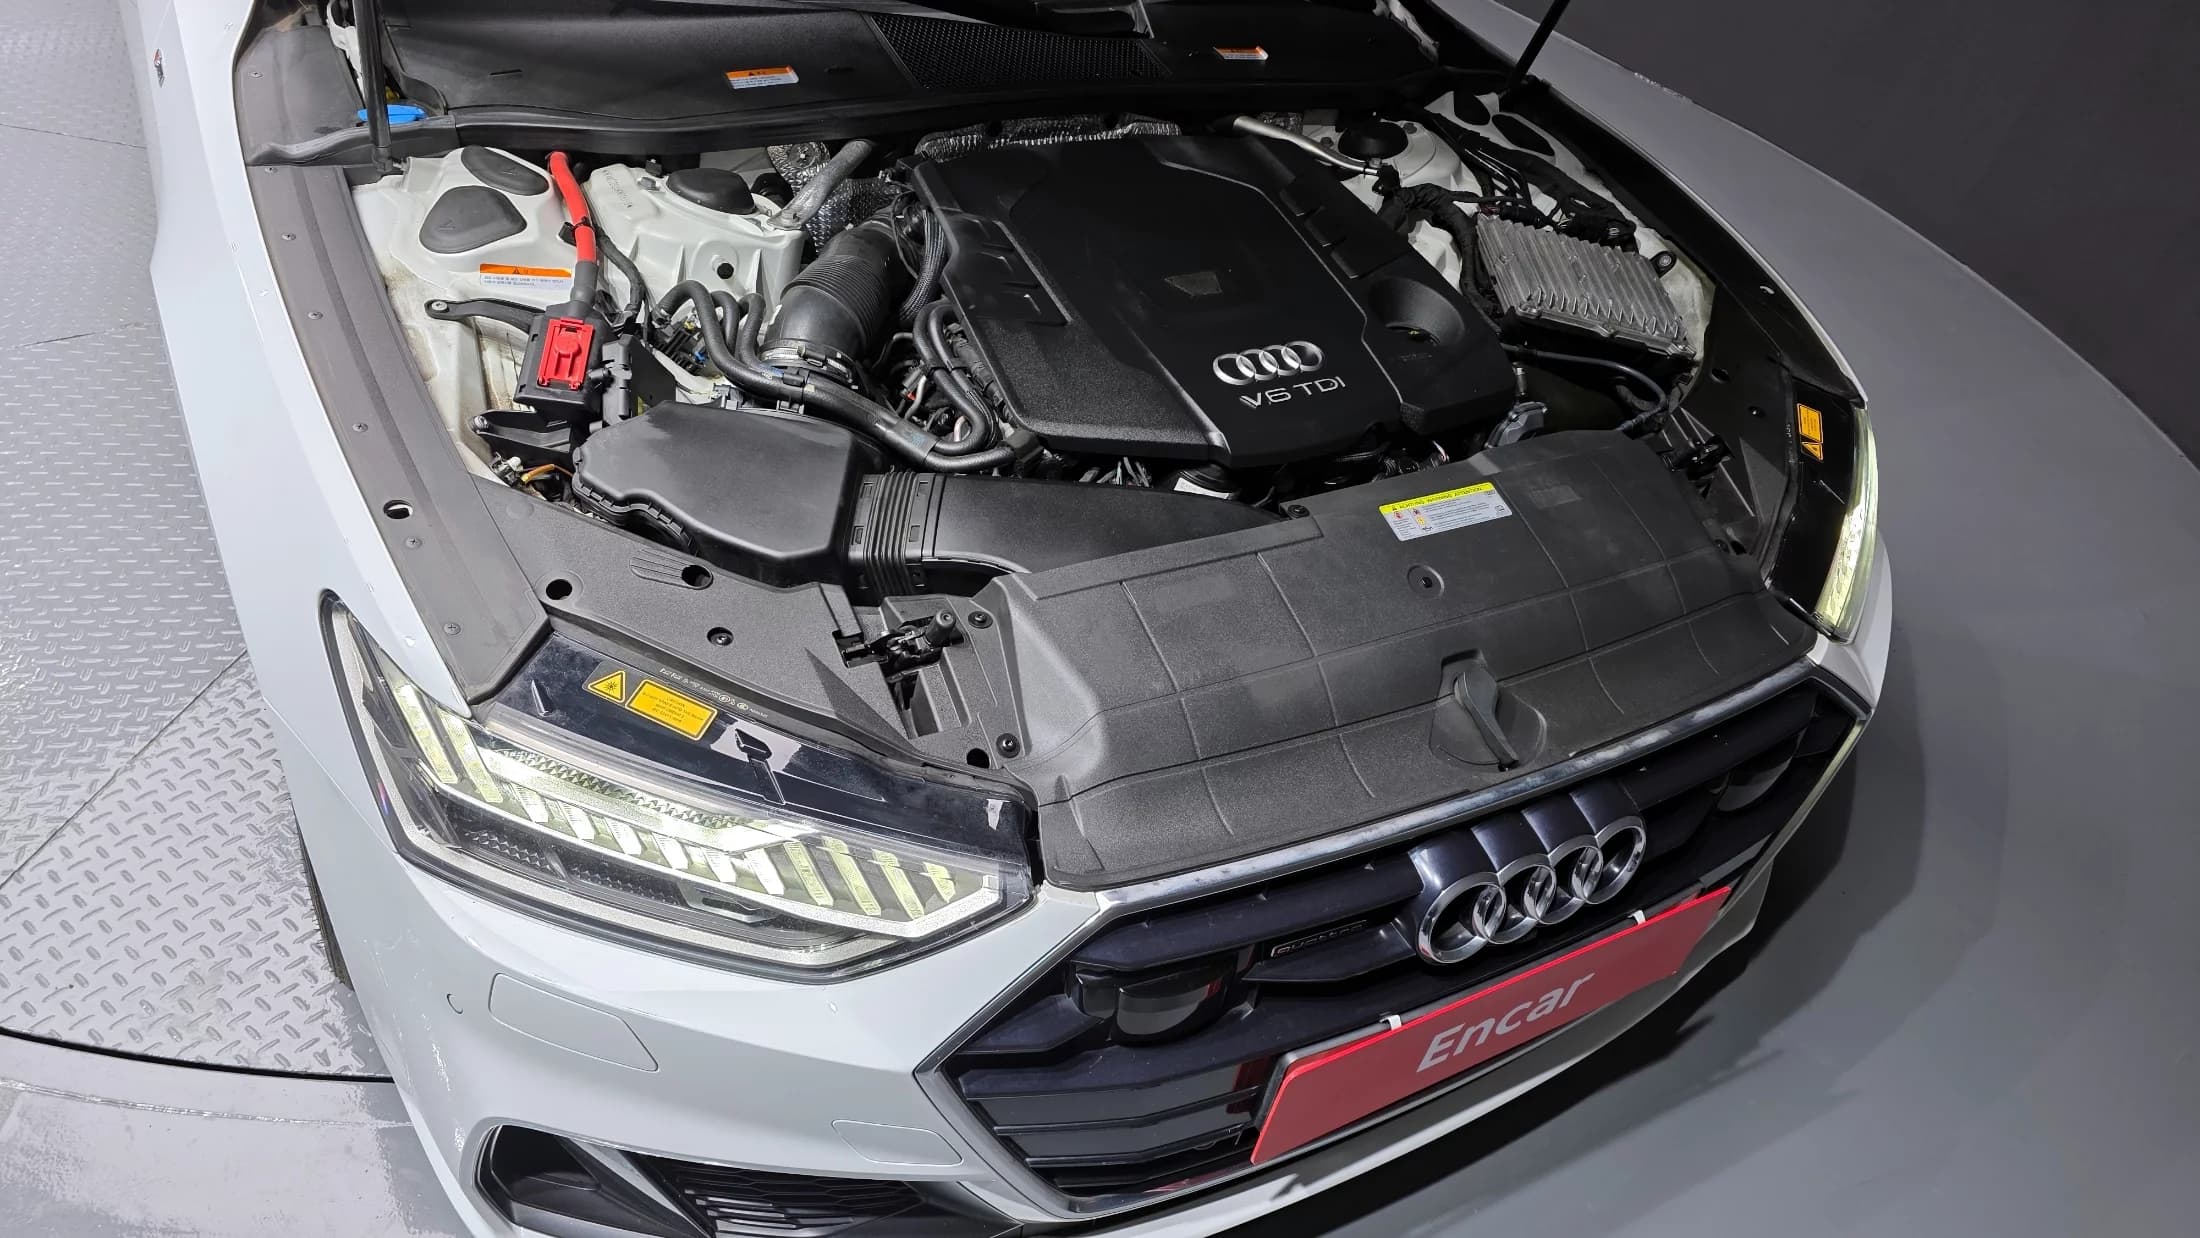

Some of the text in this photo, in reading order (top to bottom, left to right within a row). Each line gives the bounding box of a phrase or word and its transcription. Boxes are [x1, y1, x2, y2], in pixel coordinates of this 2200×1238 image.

[1240, 376, 1346, 409] V6 TDI
[1416, 972, 1596, 1073] Encar
